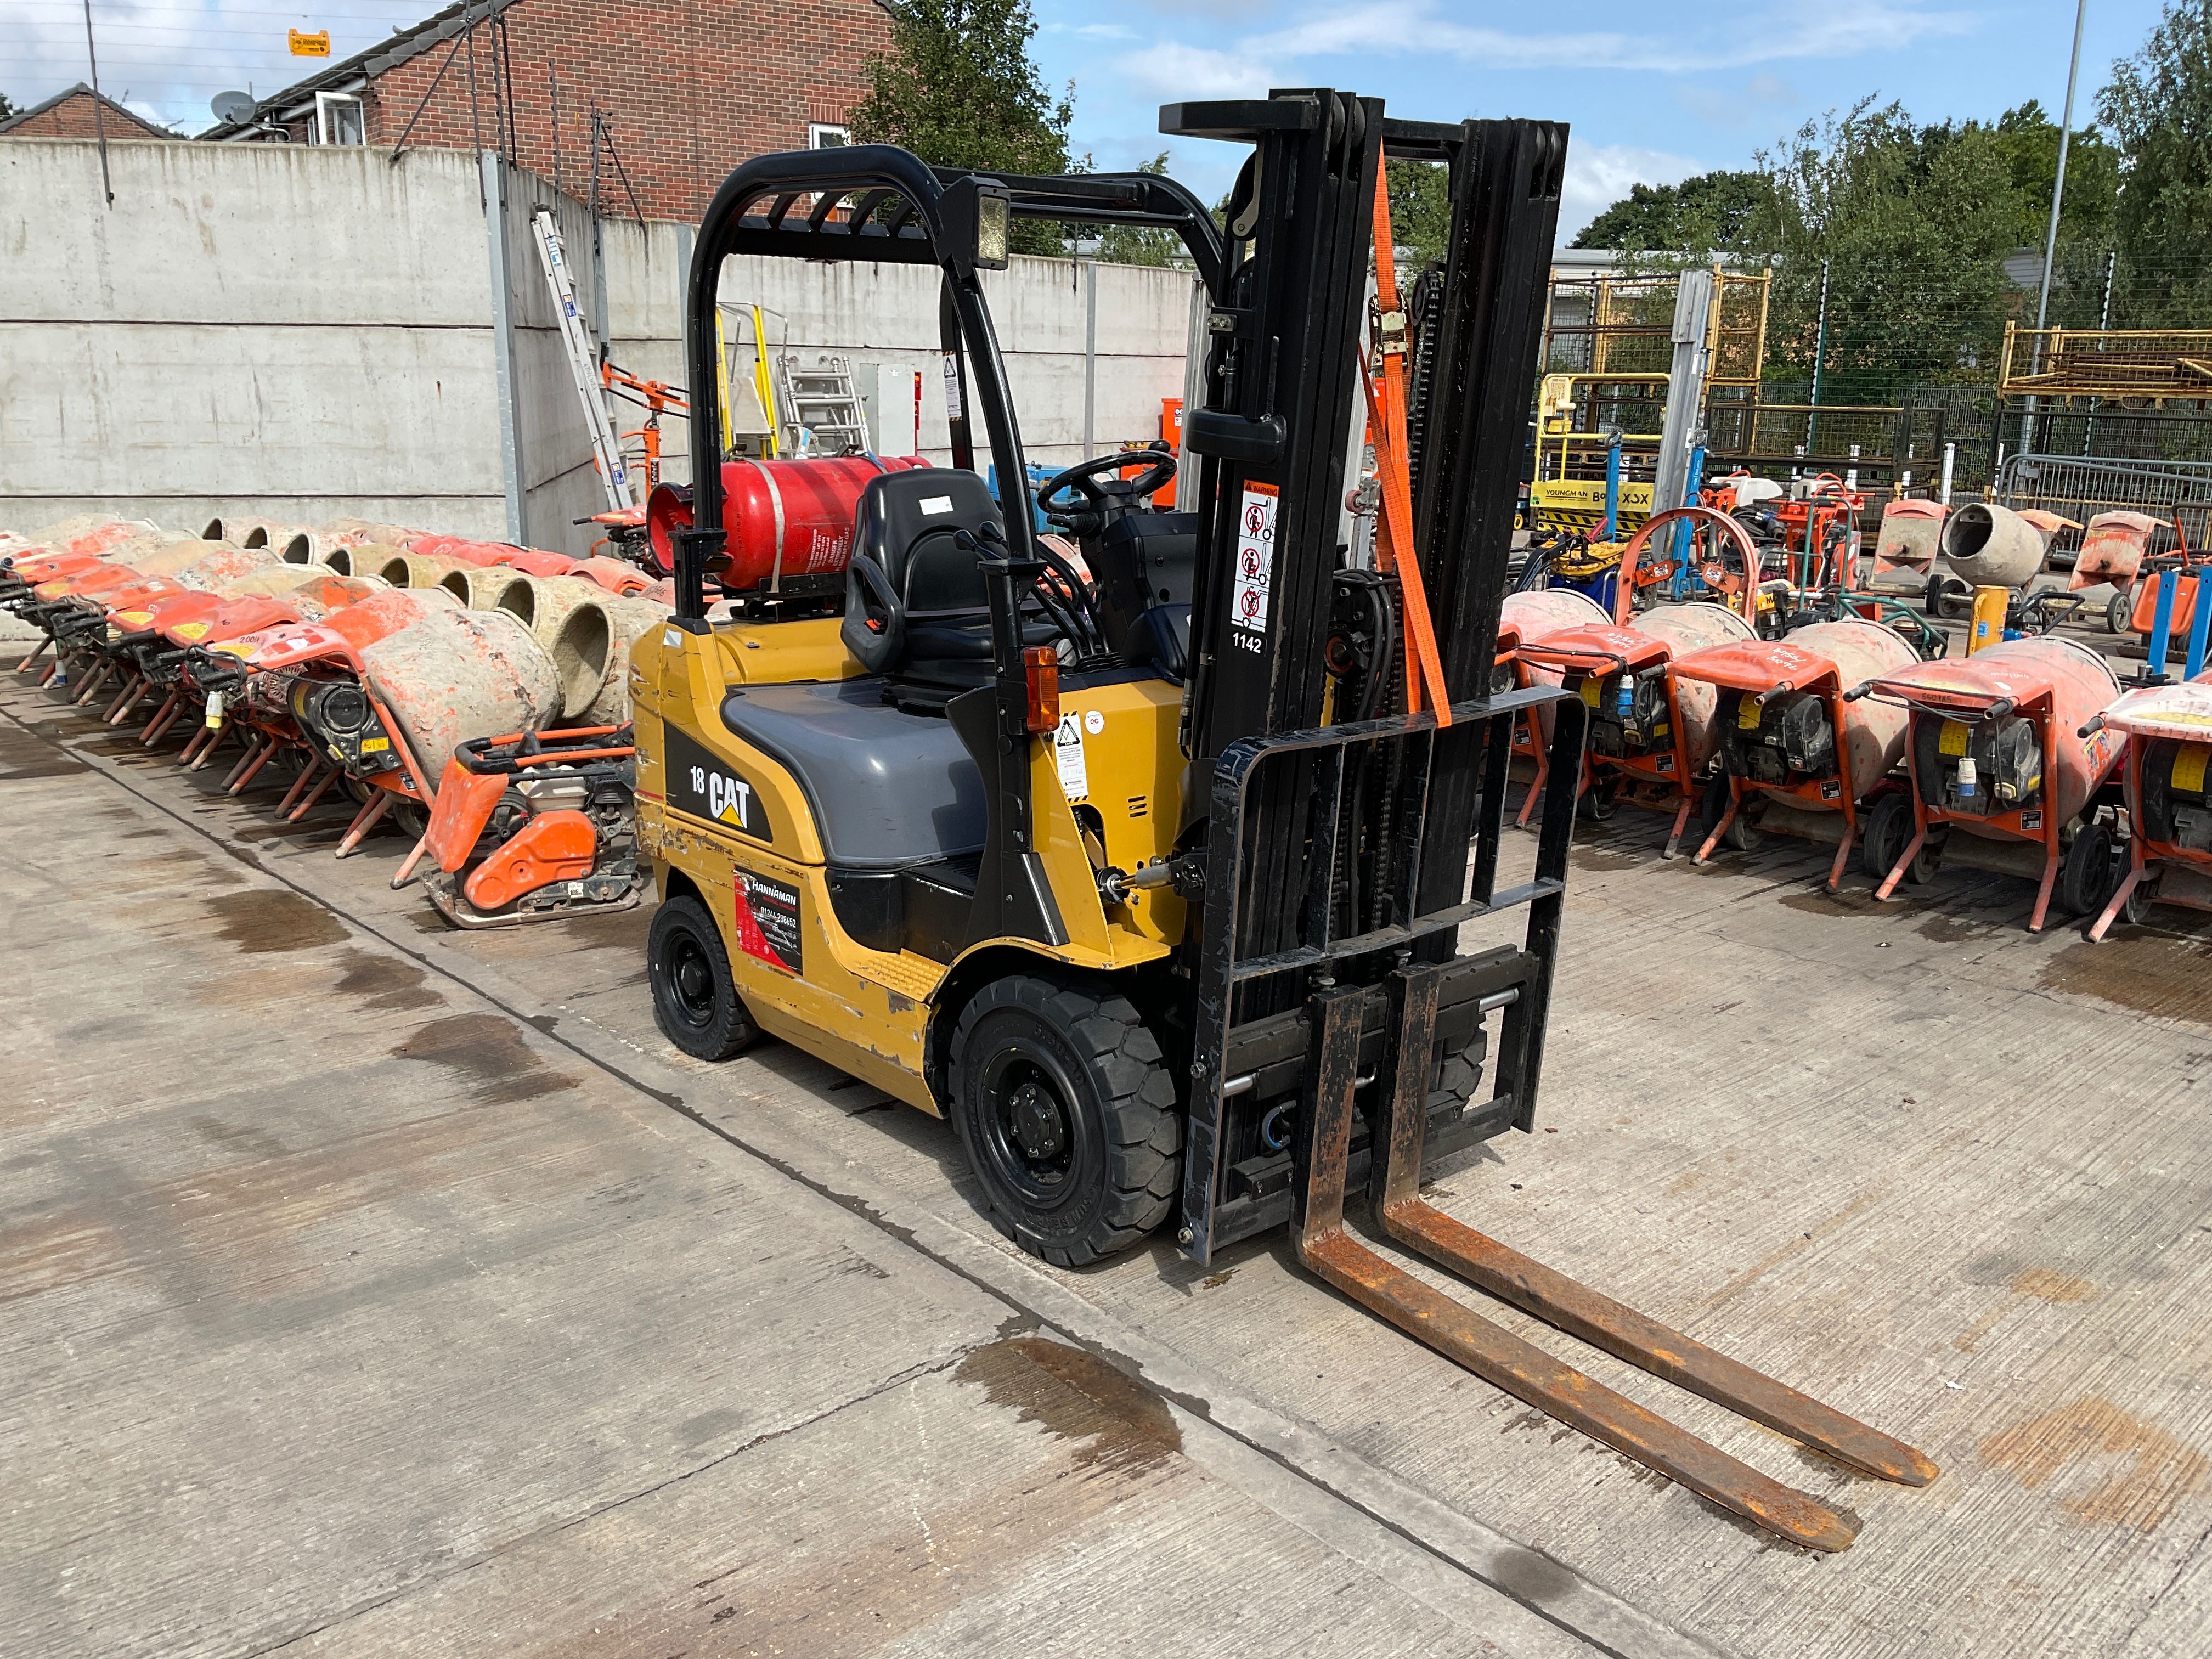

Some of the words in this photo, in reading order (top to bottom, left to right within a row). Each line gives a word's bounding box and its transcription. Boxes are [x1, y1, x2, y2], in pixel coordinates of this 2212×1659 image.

[1252, 484, 1278, 496] WARNING
[828, 540, 837, 563] DANGER
[1233, 631, 1262, 653] 1142
[690, 765, 705, 794] 18
[709, 772, 749, 828] CAT
[752, 880, 797, 905] HANNAMAN
[775, 913, 797, 929] 288652
